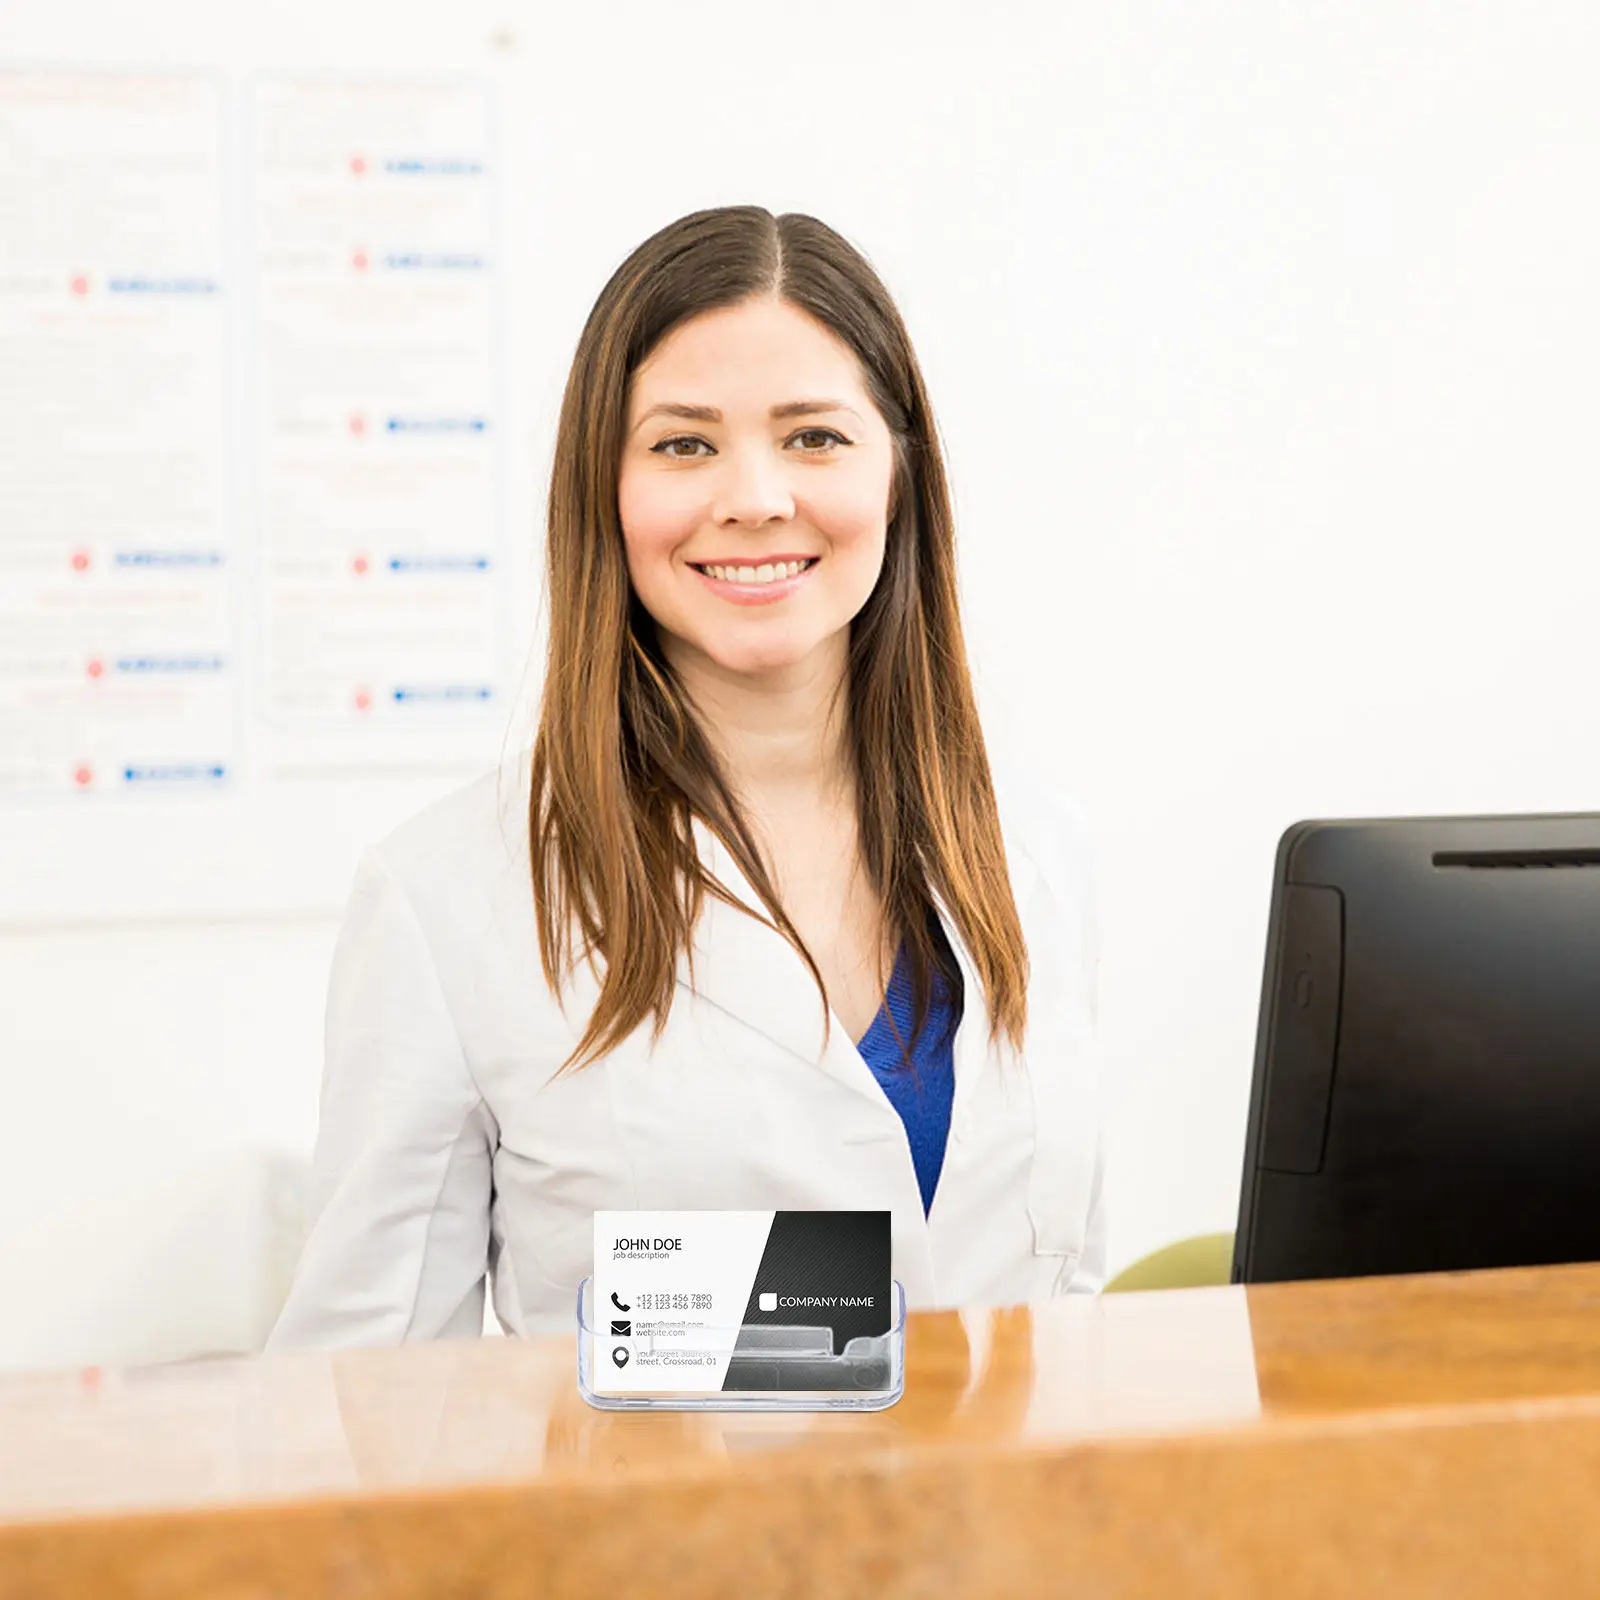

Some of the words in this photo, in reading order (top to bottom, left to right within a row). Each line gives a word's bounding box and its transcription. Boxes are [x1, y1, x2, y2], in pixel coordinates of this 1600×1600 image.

[613, 1238, 650, 1251] JOHN
[654, 1238, 682, 1251] DOE
[613, 1251, 626, 1260] job
[627, 1251, 670, 1260] description
[636, 1293, 652, 1302] +12
[655, 1293, 670, 1302] 123
[672, 1293, 689, 1302] 456
[691, 1293, 712, 1302] 7890
[779, 1296, 837, 1307] COMPANY
[840, 1296, 874, 1307] NAME
[636, 1301, 652, 1310] +12
[655, 1301, 670, 1310] 123
[672, 1301, 689, 1310] 456
[691, 1301, 712, 1310] 7890
[636, 1328, 686, 1337] website.com
[636, 1357, 661, 1367] street,
[663, 1356, 704, 1367] Crossroad,
[706, 1357, 717, 1366] 01
